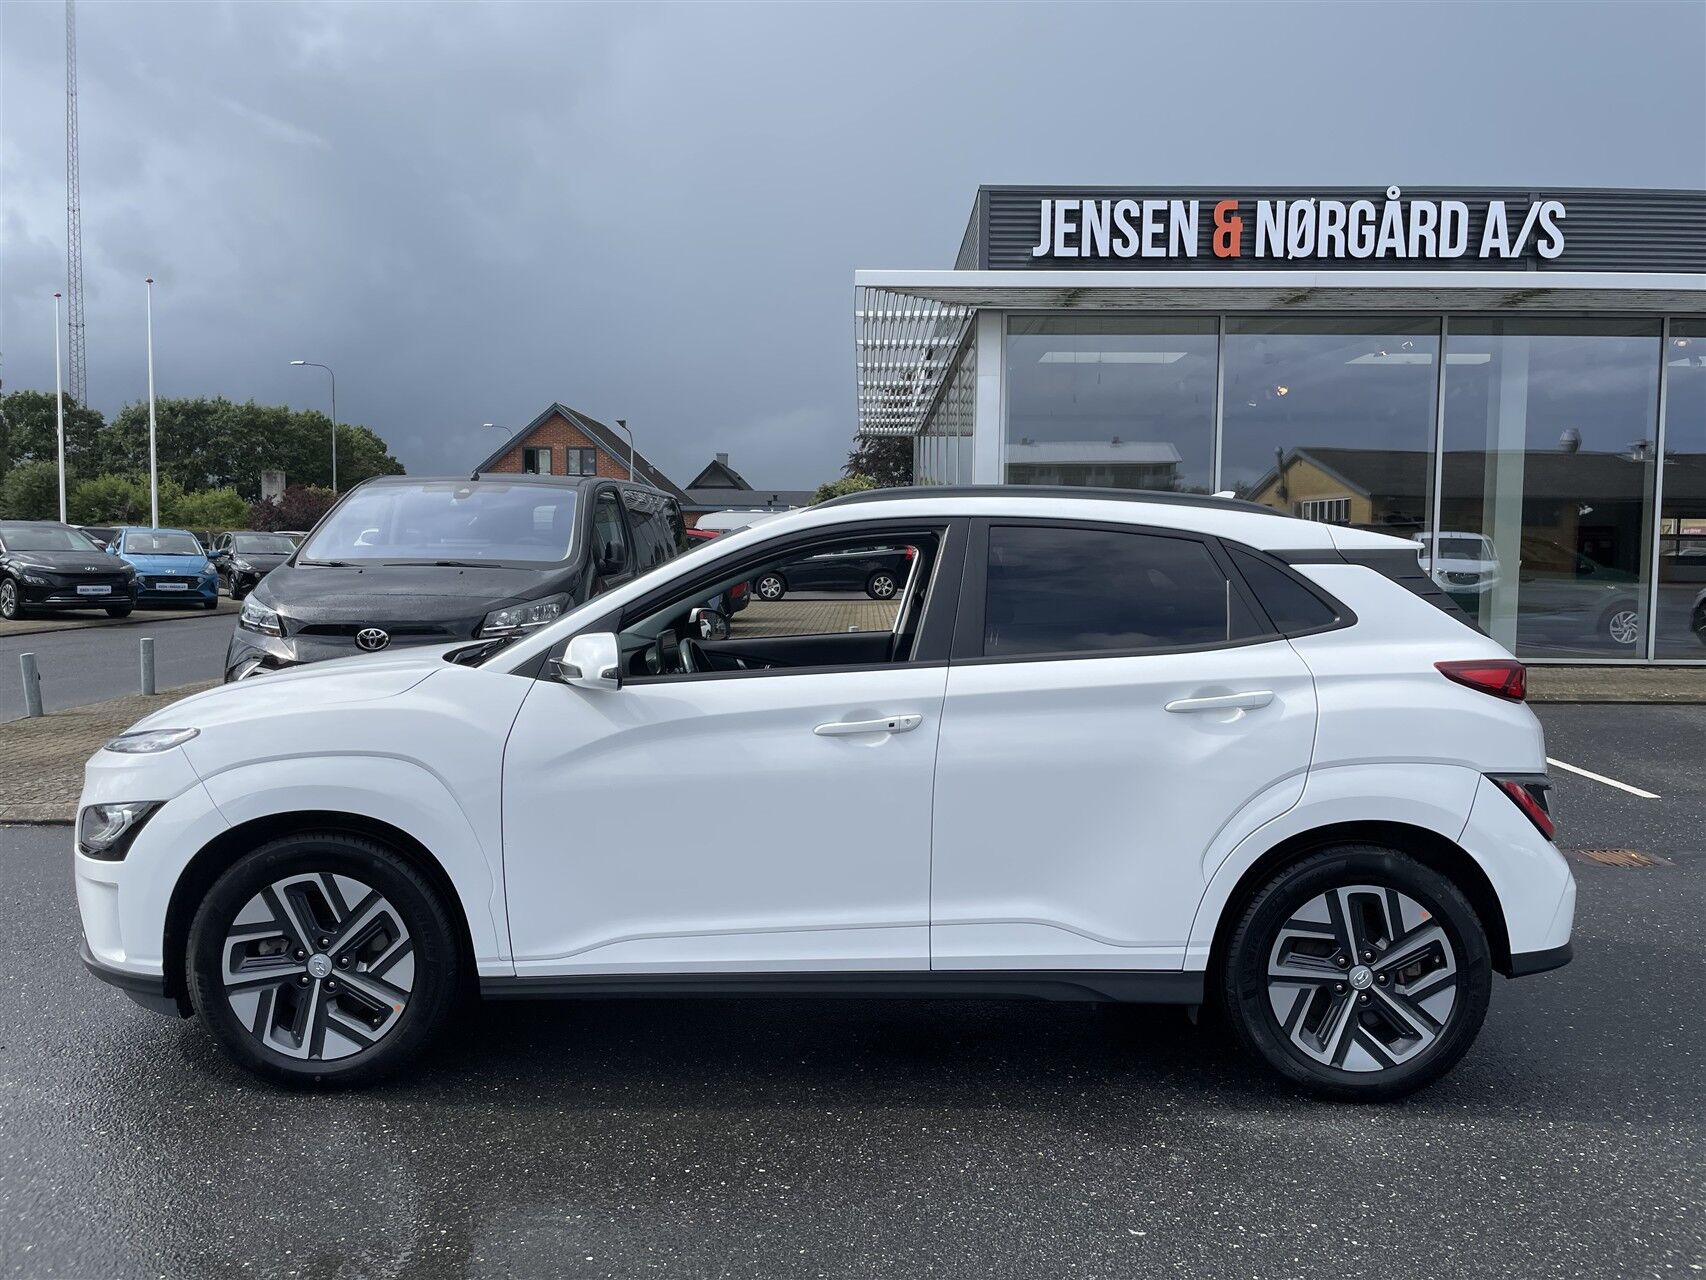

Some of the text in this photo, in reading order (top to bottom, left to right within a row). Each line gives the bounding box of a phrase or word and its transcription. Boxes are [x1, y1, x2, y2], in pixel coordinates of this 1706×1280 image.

[1032, 185, 1566, 260] JENSEN & NØRGÅRD A/S
